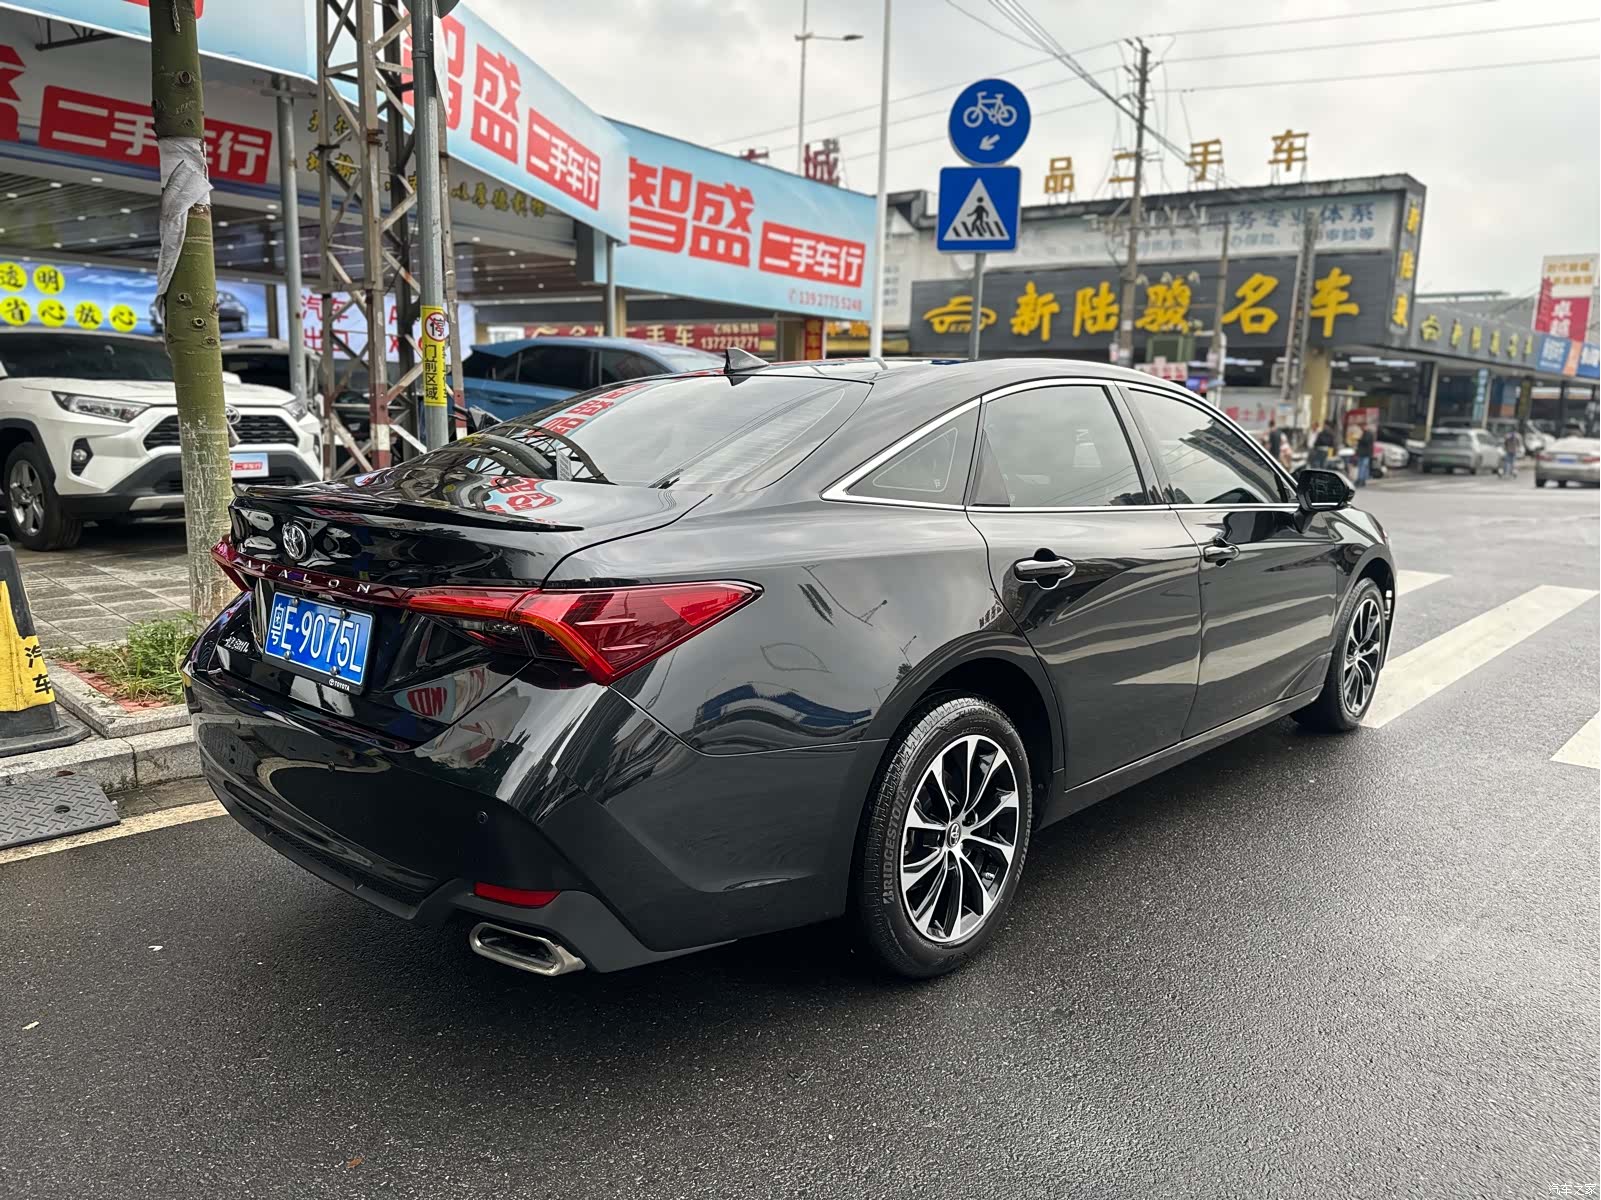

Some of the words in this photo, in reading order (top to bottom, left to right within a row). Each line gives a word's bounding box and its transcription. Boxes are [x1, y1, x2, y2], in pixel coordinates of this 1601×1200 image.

[52, 99, 266, 176] 二手行
[530, 124, 599, 203] 二手车行
[629, 156, 755, 268] 智盛
[764, 231, 862, 282] 二手车行
[4, 299, 134, 326] 省心放心
[1009, 267, 1360, 342] 新陆骏名车
[424, 344, 438, 400] 门前区域
